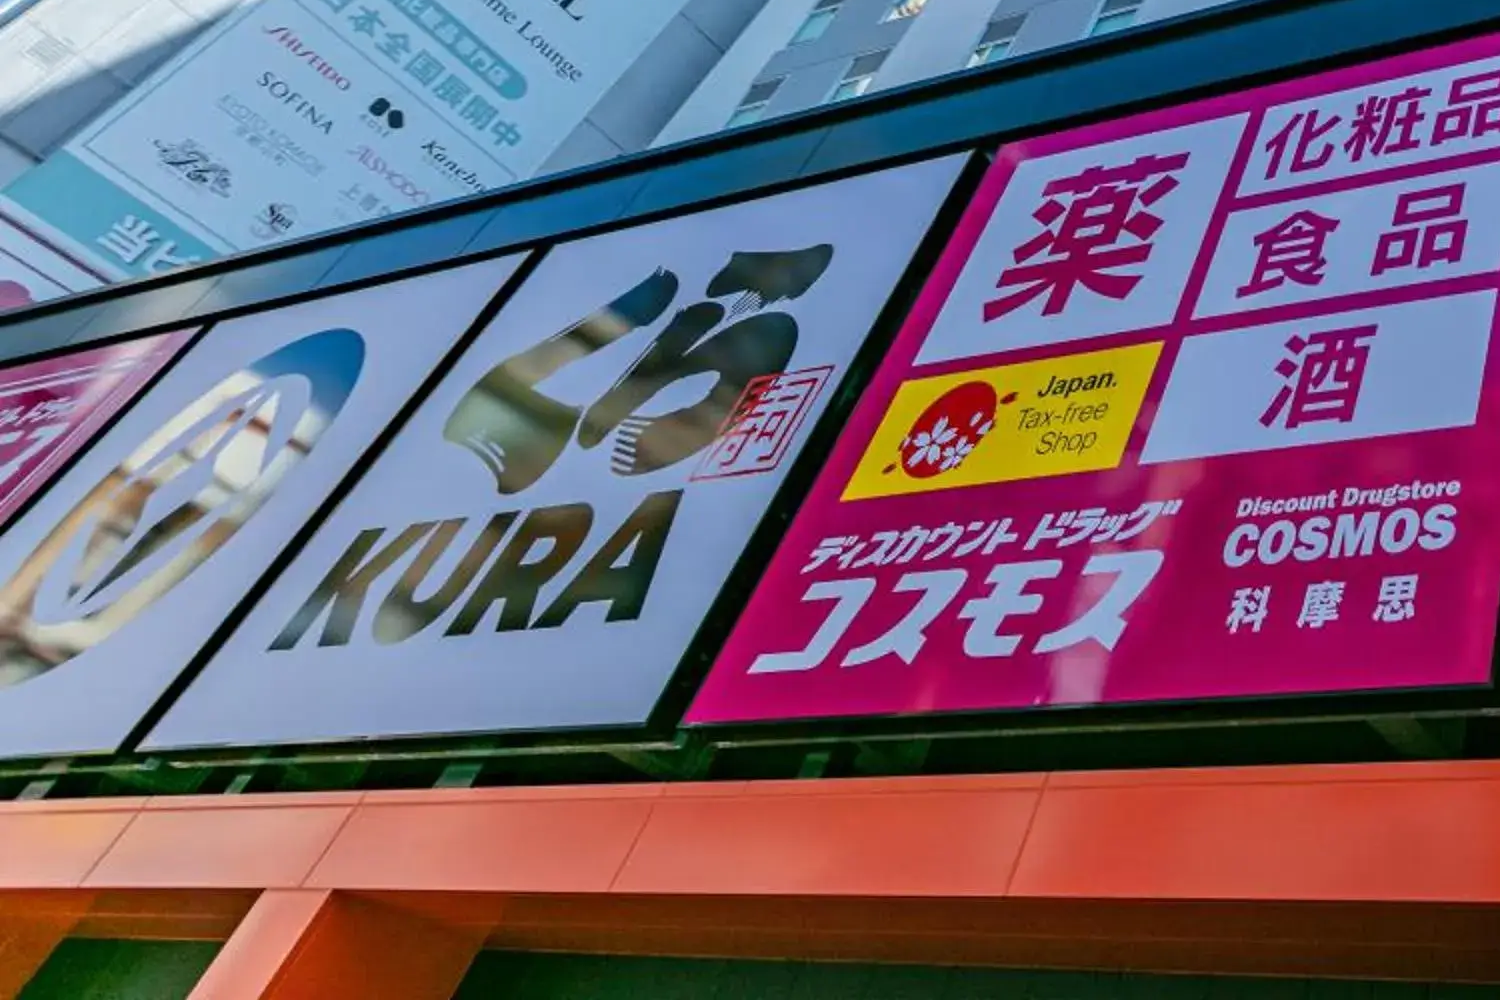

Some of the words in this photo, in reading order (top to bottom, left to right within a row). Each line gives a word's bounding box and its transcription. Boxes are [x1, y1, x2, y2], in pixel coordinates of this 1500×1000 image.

[263, 25, 352, 92] SHISEIDO
[517, 19, 583, 83] Lounge
[256, 70, 334, 136] SOFINA
[982, 151, 1190, 322] 薬
[1236, 182, 1469, 299] 食品
[1259, 324, 1378, 429] 酒
[1018, 402, 1109, 431] Tax-free
[1036, 430, 1098, 455] Shop
[1235, 489, 1338, 518] Discount
[1341, 480, 1461, 507] Drugstore
[800, 516, 1019, 575] ディスカウント
[1024, 499, 1184, 551] ドラッグ
[1223, 503, 1457, 568] COSMOS
[267, 489, 684, 651] KURA
[746, 550, 1165, 675] コスモス
[1225, 573, 1419, 635] 科摩思
